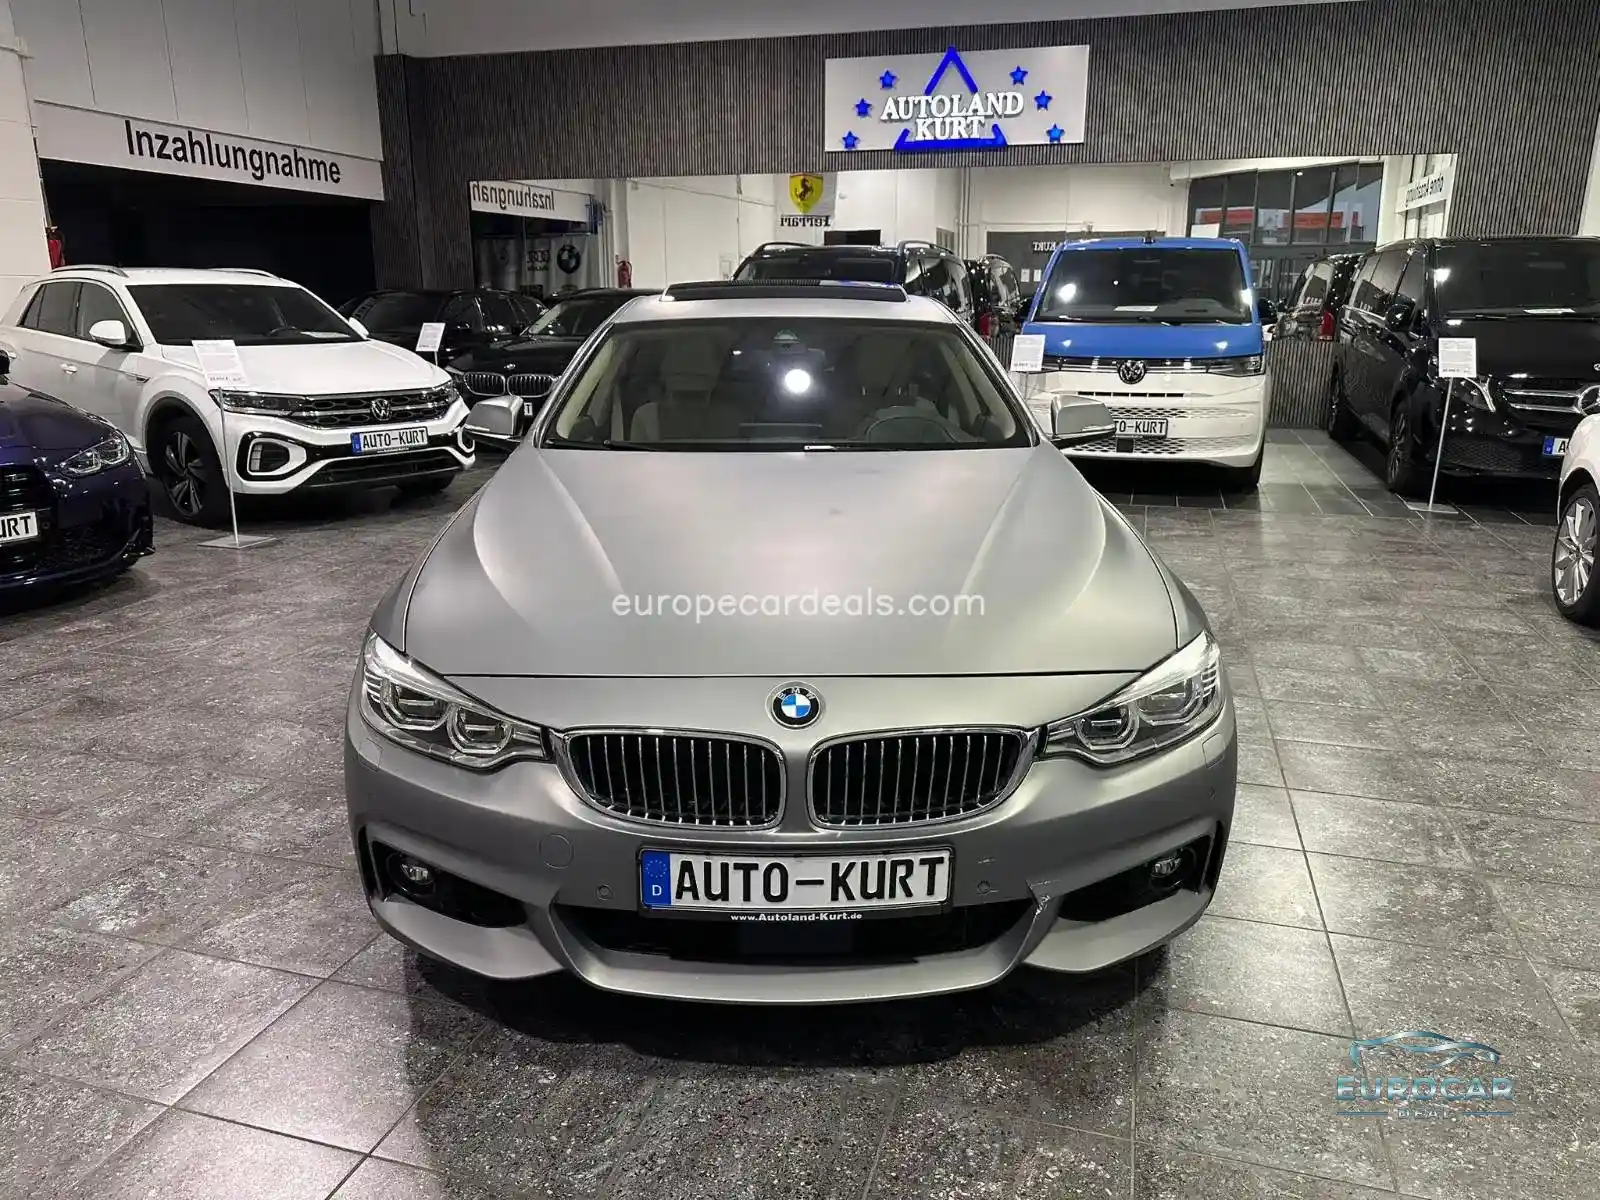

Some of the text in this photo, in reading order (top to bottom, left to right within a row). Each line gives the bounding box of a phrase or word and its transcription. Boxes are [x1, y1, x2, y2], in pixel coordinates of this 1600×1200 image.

[881, 92, 1023, 120] AUTOLAND
[915, 116, 986, 141] KURT
[124, 119, 341, 184] Inzahlungnahme
[362, 429, 427, 449] AUTO-KURT
[651, 884, 663, 897] D
[674, 856, 945, 903] AUTO-KURT
[730, 912, 863, 922] www.Autoland-Kurt.de
